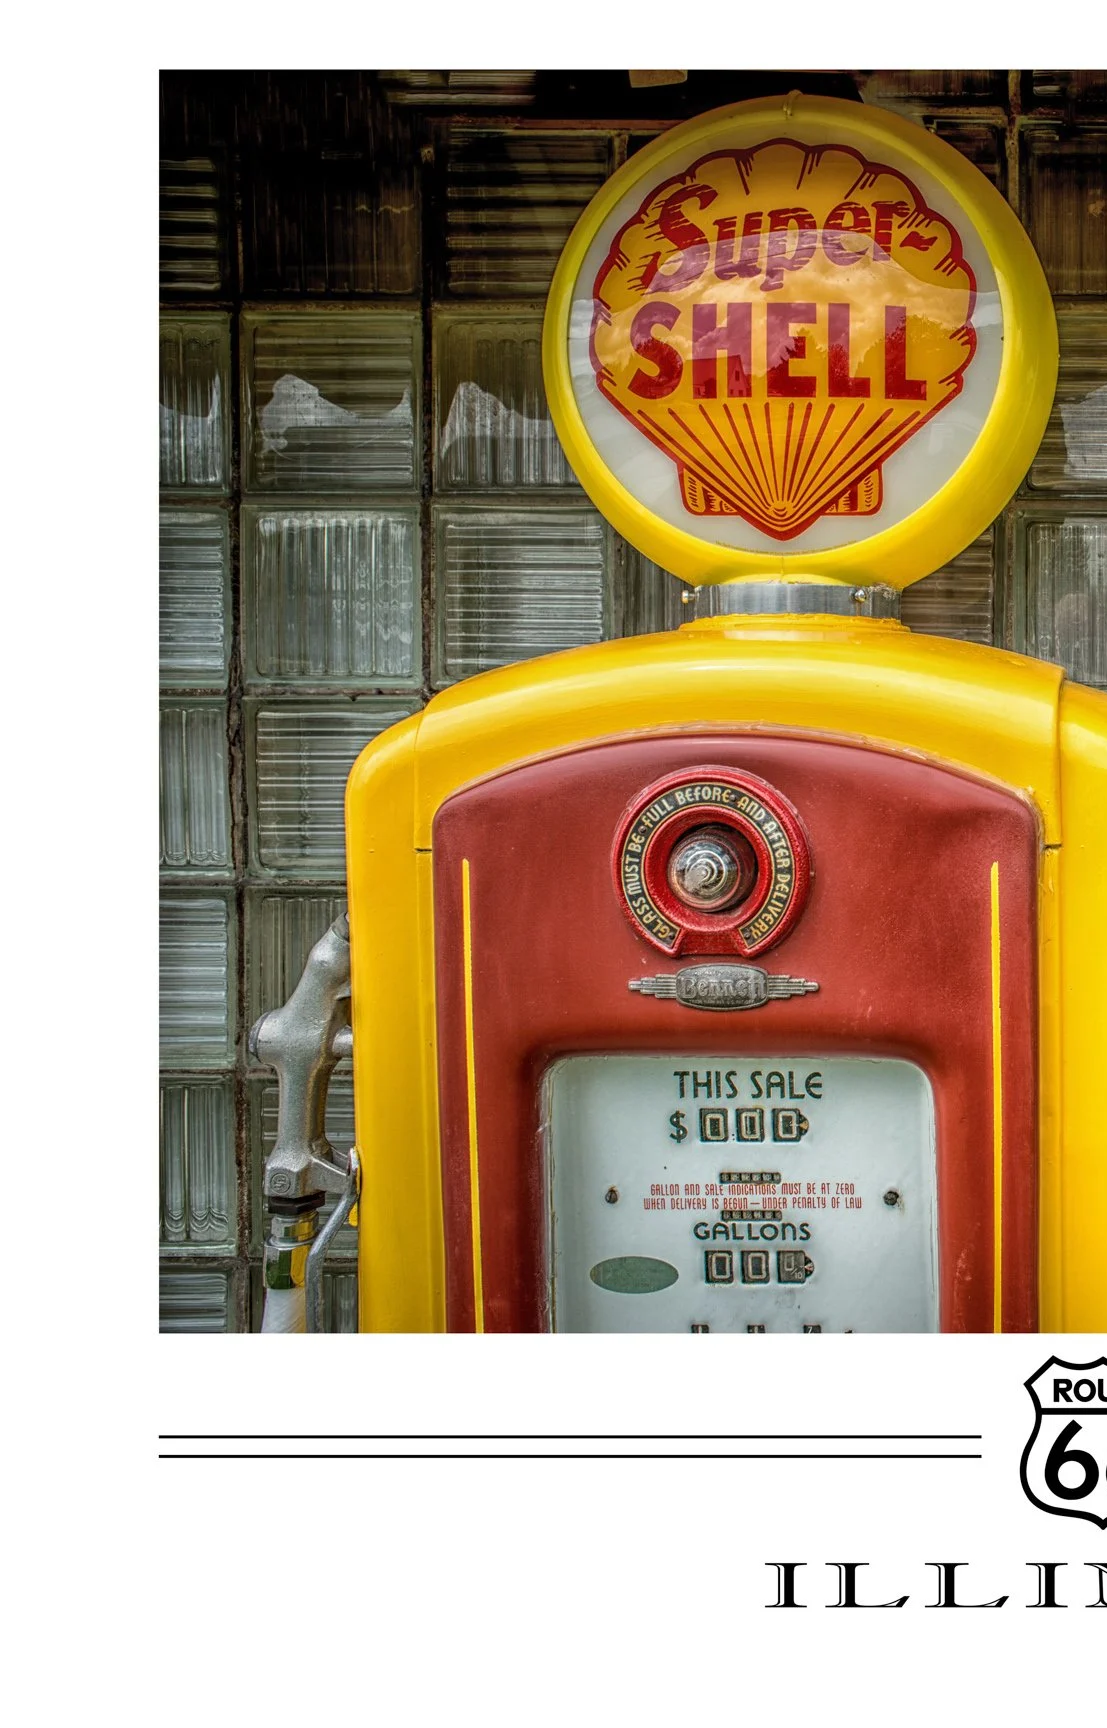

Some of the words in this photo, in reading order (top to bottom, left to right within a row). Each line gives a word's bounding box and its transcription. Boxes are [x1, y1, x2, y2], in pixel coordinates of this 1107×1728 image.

[628, 301, 928, 401] SHELL
[675, 785, 732, 806] BEFORE
[737, 796, 766, 821] AND
[642, 801, 674, 830] FULL
[629, 833, 646, 851] BE
[763, 821, 791, 868] AFTER
[625, 854, 641, 894] MUST
[631, 898, 670, 940] GLASS
[751, 873, 791, 939] DELIVERY
[673, 1071, 738, 1099] THIS
[750, 1071, 823, 1099] SALE
[643, 1198, 666, 1210] WHEN
[670, 1198, 707, 1210] DELIVERY
[711, 1198, 719, 1210] IS
[792, 1197, 826, 1209] PENALTY
[831, 1197, 840, 1209] OF
[845, 1197, 862, 1209] LAW
[650, 1183, 680, 1196] GALLON
[684, 1183, 701, 1196] AND
[705, 1183, 724, 1196] SALE
[728, 1183, 777, 1195] INDICATIONS
[781, 1183, 802, 1195] MUST
[806, 1183, 817, 1195] BE
[821, 1183, 831, 1195] AT
[835, 1183, 855, 1195] ZERO
[693, 1221, 812, 1240] GALLONS
